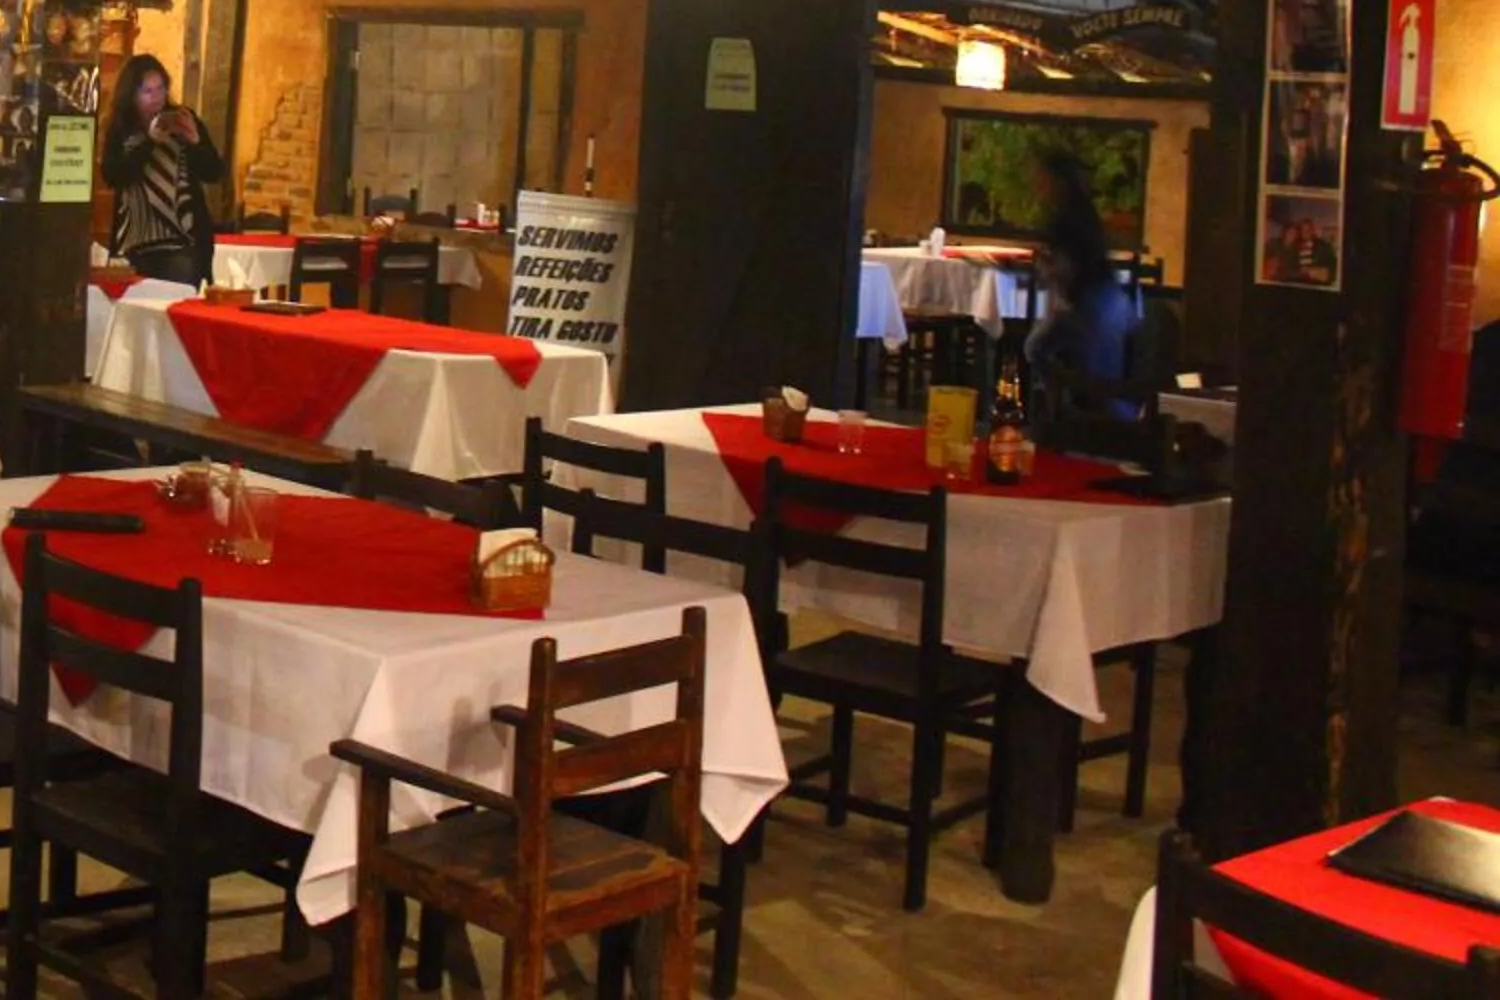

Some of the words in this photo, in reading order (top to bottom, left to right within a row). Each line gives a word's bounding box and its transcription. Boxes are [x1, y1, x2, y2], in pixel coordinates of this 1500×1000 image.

[518, 225, 618, 254] SERVIMOS
[515, 255, 614, 284] REFEIÇÕES
[512, 286, 590, 312] PRATOS
[510, 316, 553, 339] TIRA
[556, 320, 619, 344] GOSTO
